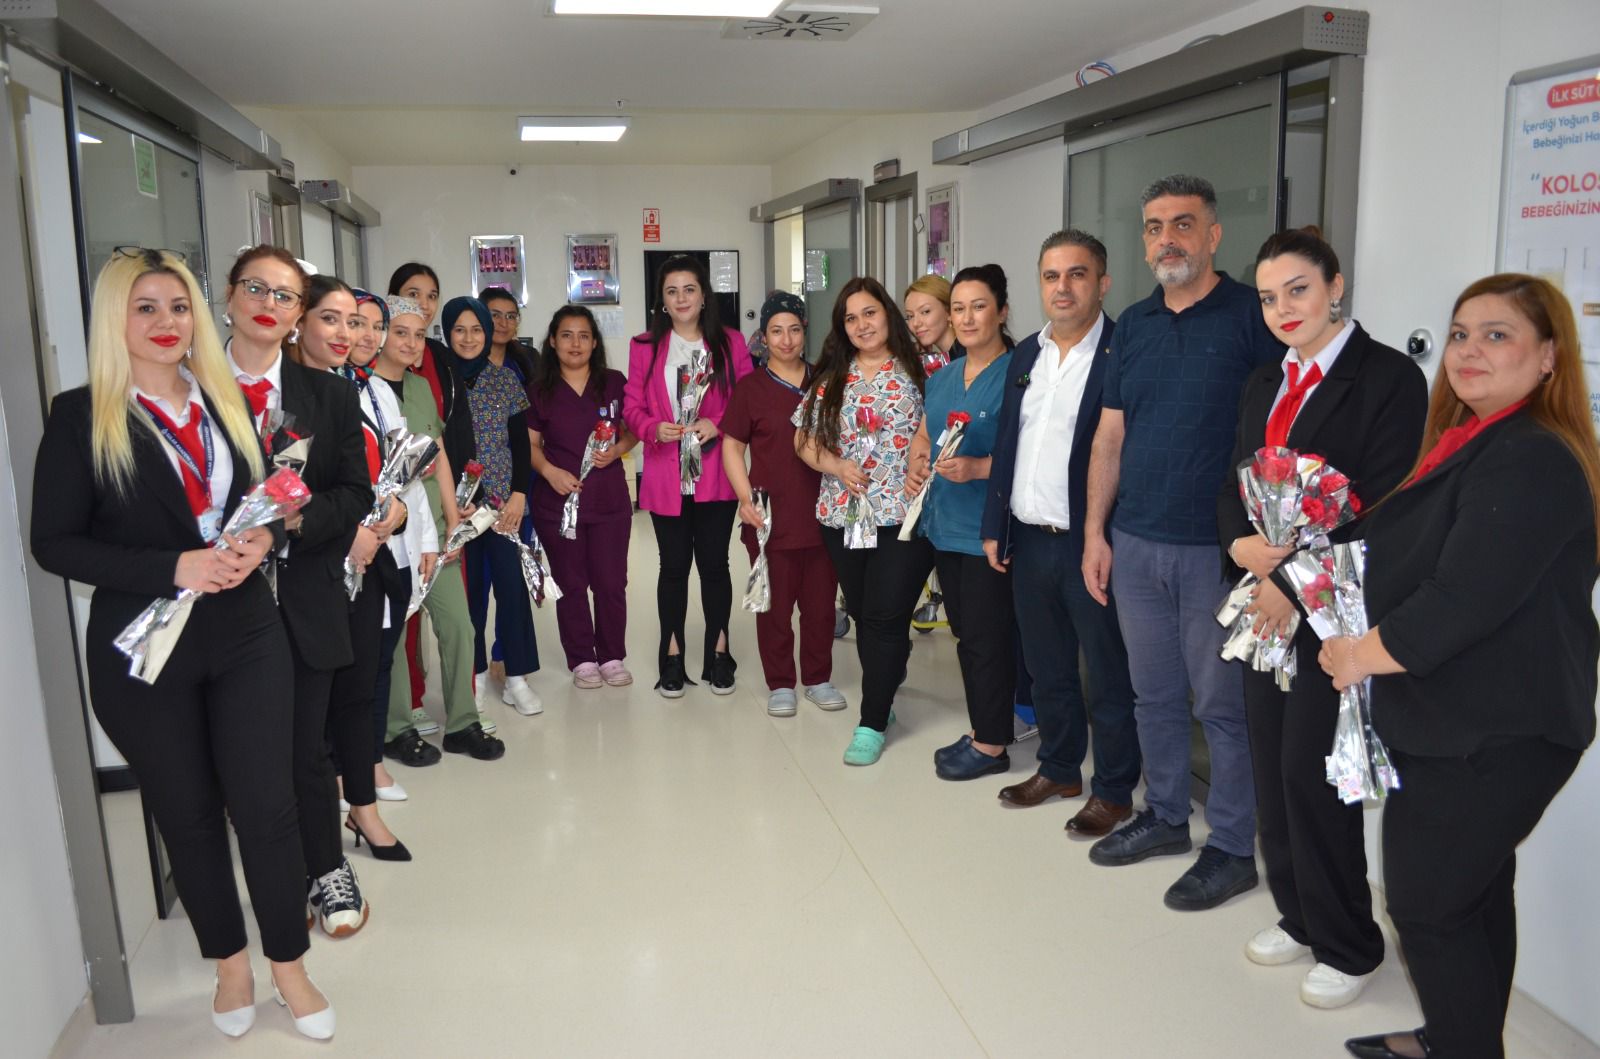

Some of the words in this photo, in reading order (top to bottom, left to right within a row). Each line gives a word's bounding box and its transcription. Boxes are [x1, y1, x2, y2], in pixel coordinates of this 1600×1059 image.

[1571, 83, 1595, 100] SÜT
[1558, 114, 1589, 129] Yoğun
[1533, 133, 1582, 149] Bebeğinizi
[1521, 199, 1600, 218] BEBEĞİNİZİN
